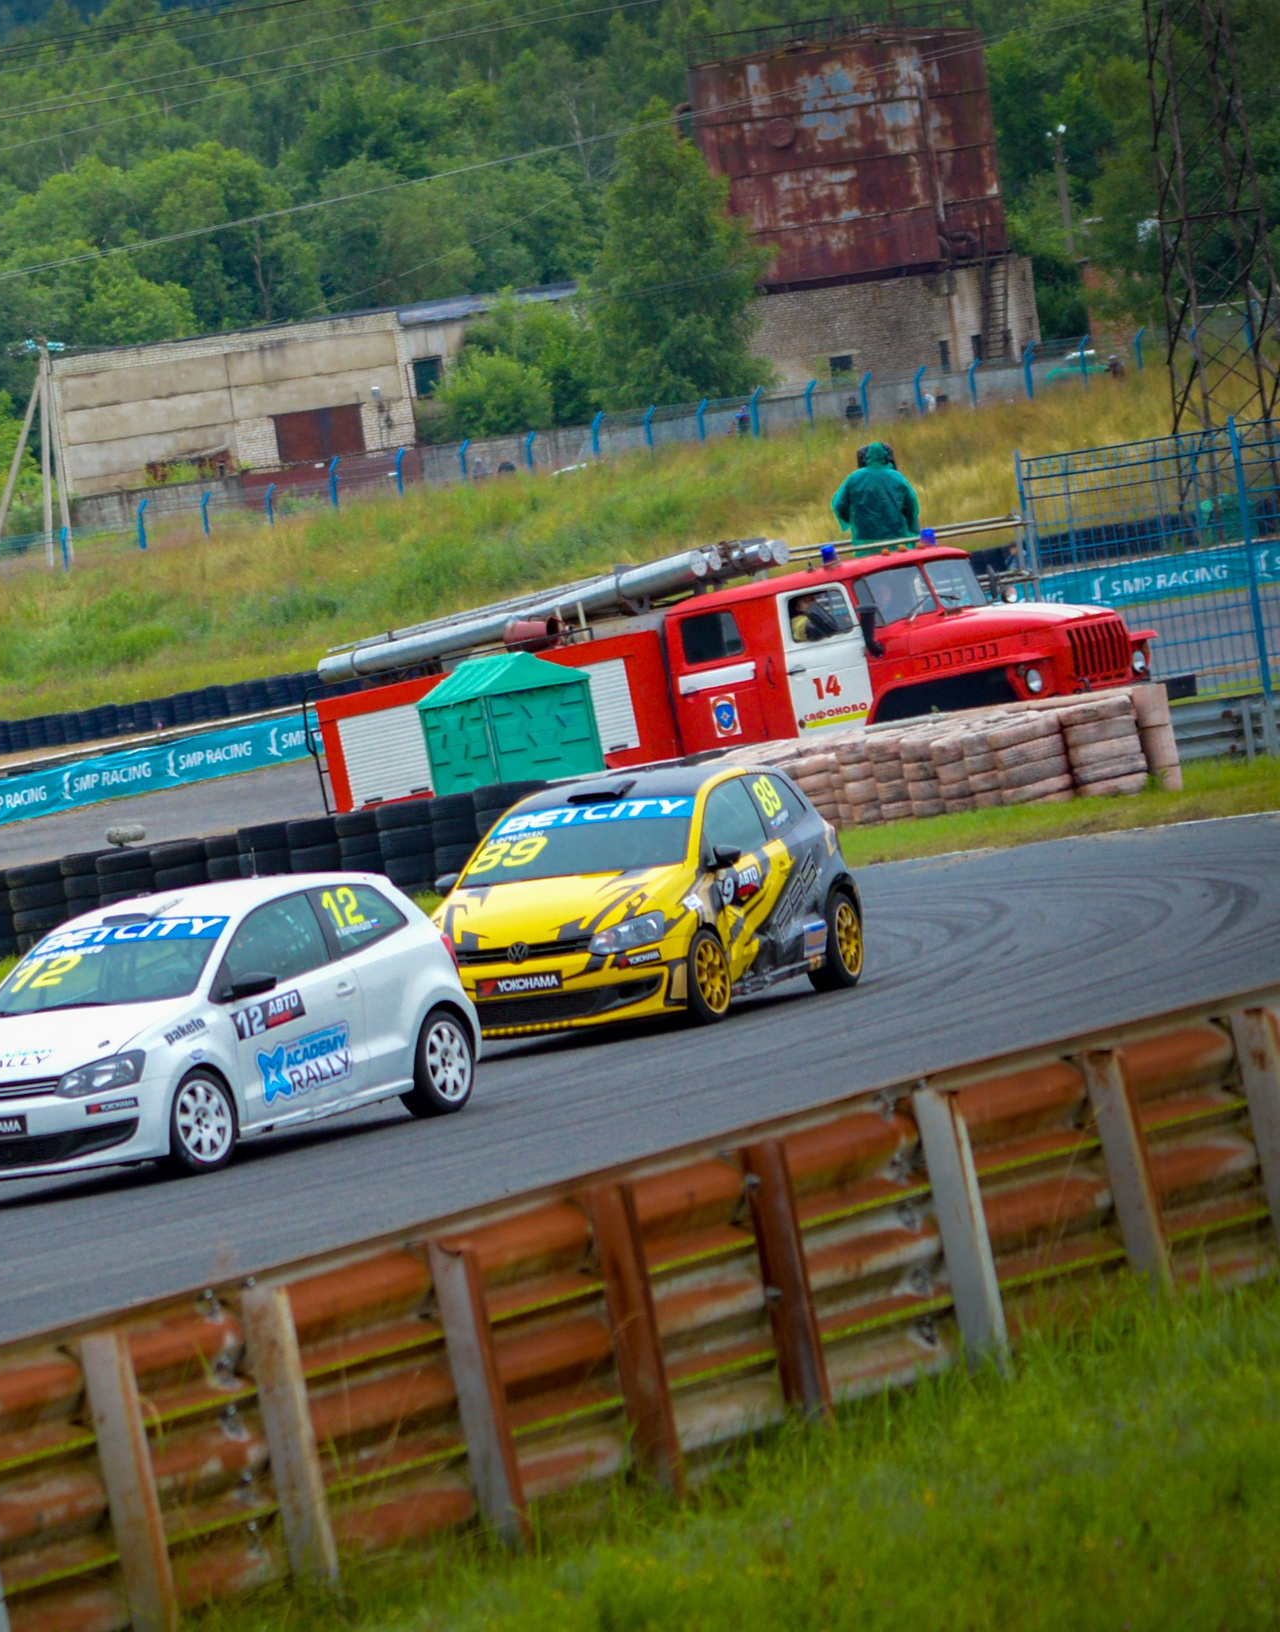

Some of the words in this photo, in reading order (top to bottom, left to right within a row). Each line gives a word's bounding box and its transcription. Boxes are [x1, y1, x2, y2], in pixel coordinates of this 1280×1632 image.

[1111, 576, 1151, 597] SMP
[1155, 564, 1229, 590] RACING
[812, 674, 841, 700] 14
[803, 702, 868, 721] САФОНОВО
[178, 750, 205, 770] SMP
[206, 740, 253, 764] RACING
[73, 771, 100, 793] SMP
[102, 762, 152, 784] RACING
[5, 786, 47, 809] RACING
[752, 775, 782, 817] 89
[497, 799, 689, 835] BETCITY
[467, 836, 548, 875] 89
[322, 886, 365, 928] 12
[33, 917, 222, 956] BETCITY
[11, 954, 82, 993] 12
[627, 951, 661, 965] YOKOHAMA
[497, 974, 559, 993] YOKOHAMA
[164, 1017, 206, 1046] pakelo
[236, 1006, 266, 1038] 12
[286, 1033, 347, 1068] ACADEMY
[289, 1050, 351, 1092] RALLY
